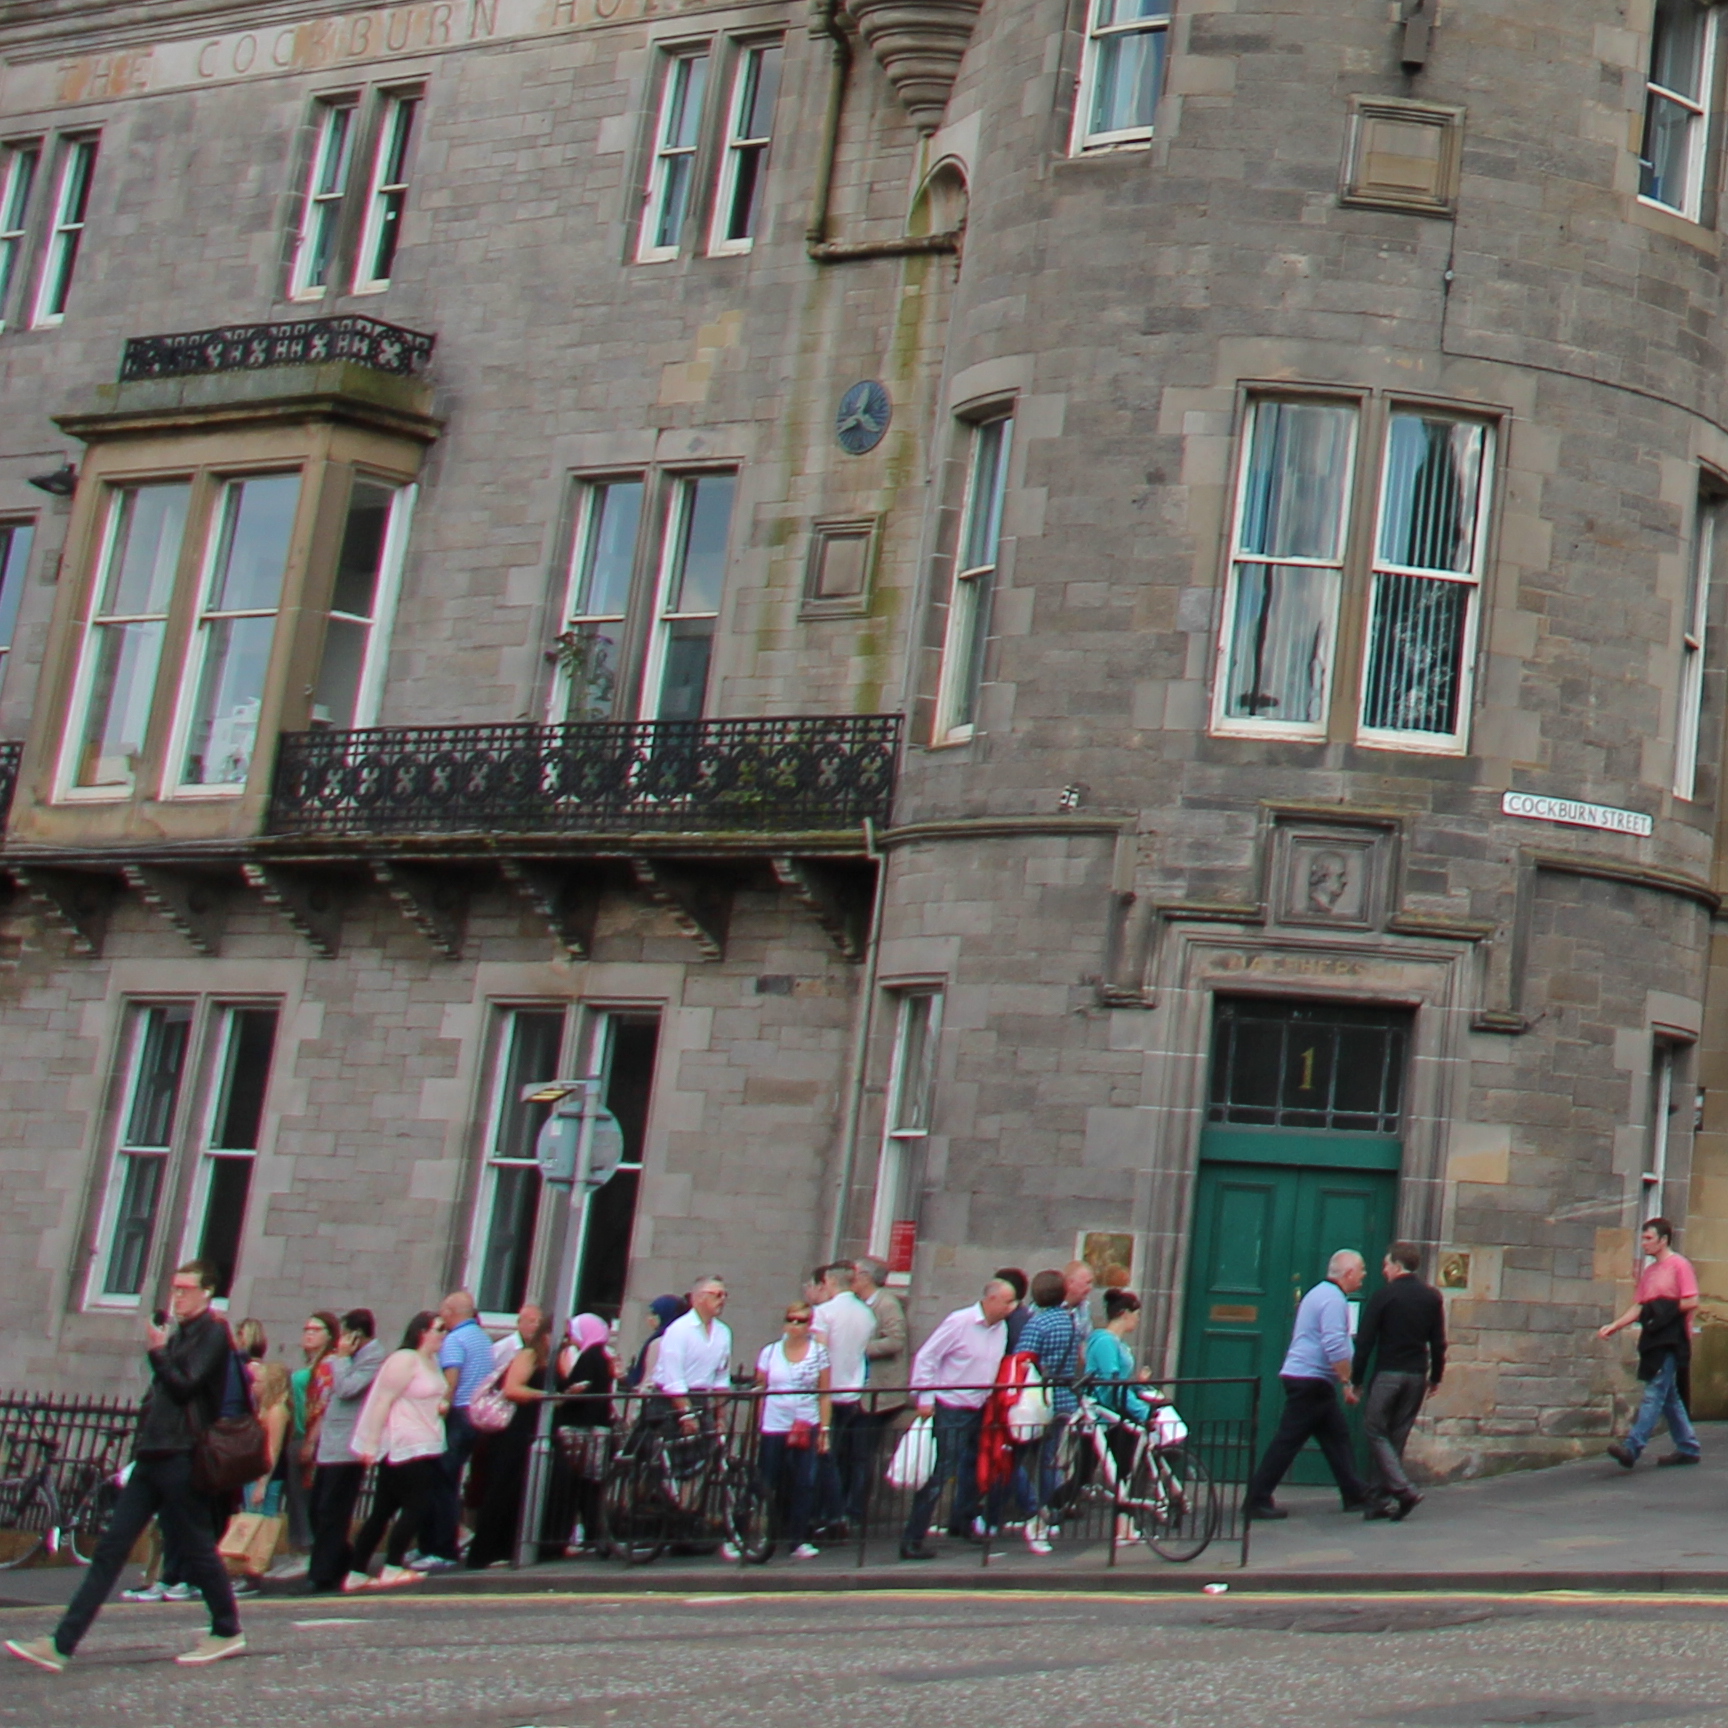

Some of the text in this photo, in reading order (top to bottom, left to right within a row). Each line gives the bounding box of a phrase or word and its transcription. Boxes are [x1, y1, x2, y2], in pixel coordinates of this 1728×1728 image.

[57, 48, 153, 101] THE
[1508, 795, 1648, 833] COCKBURN STREET
[1299, 1047, 1315, 1090] 1
